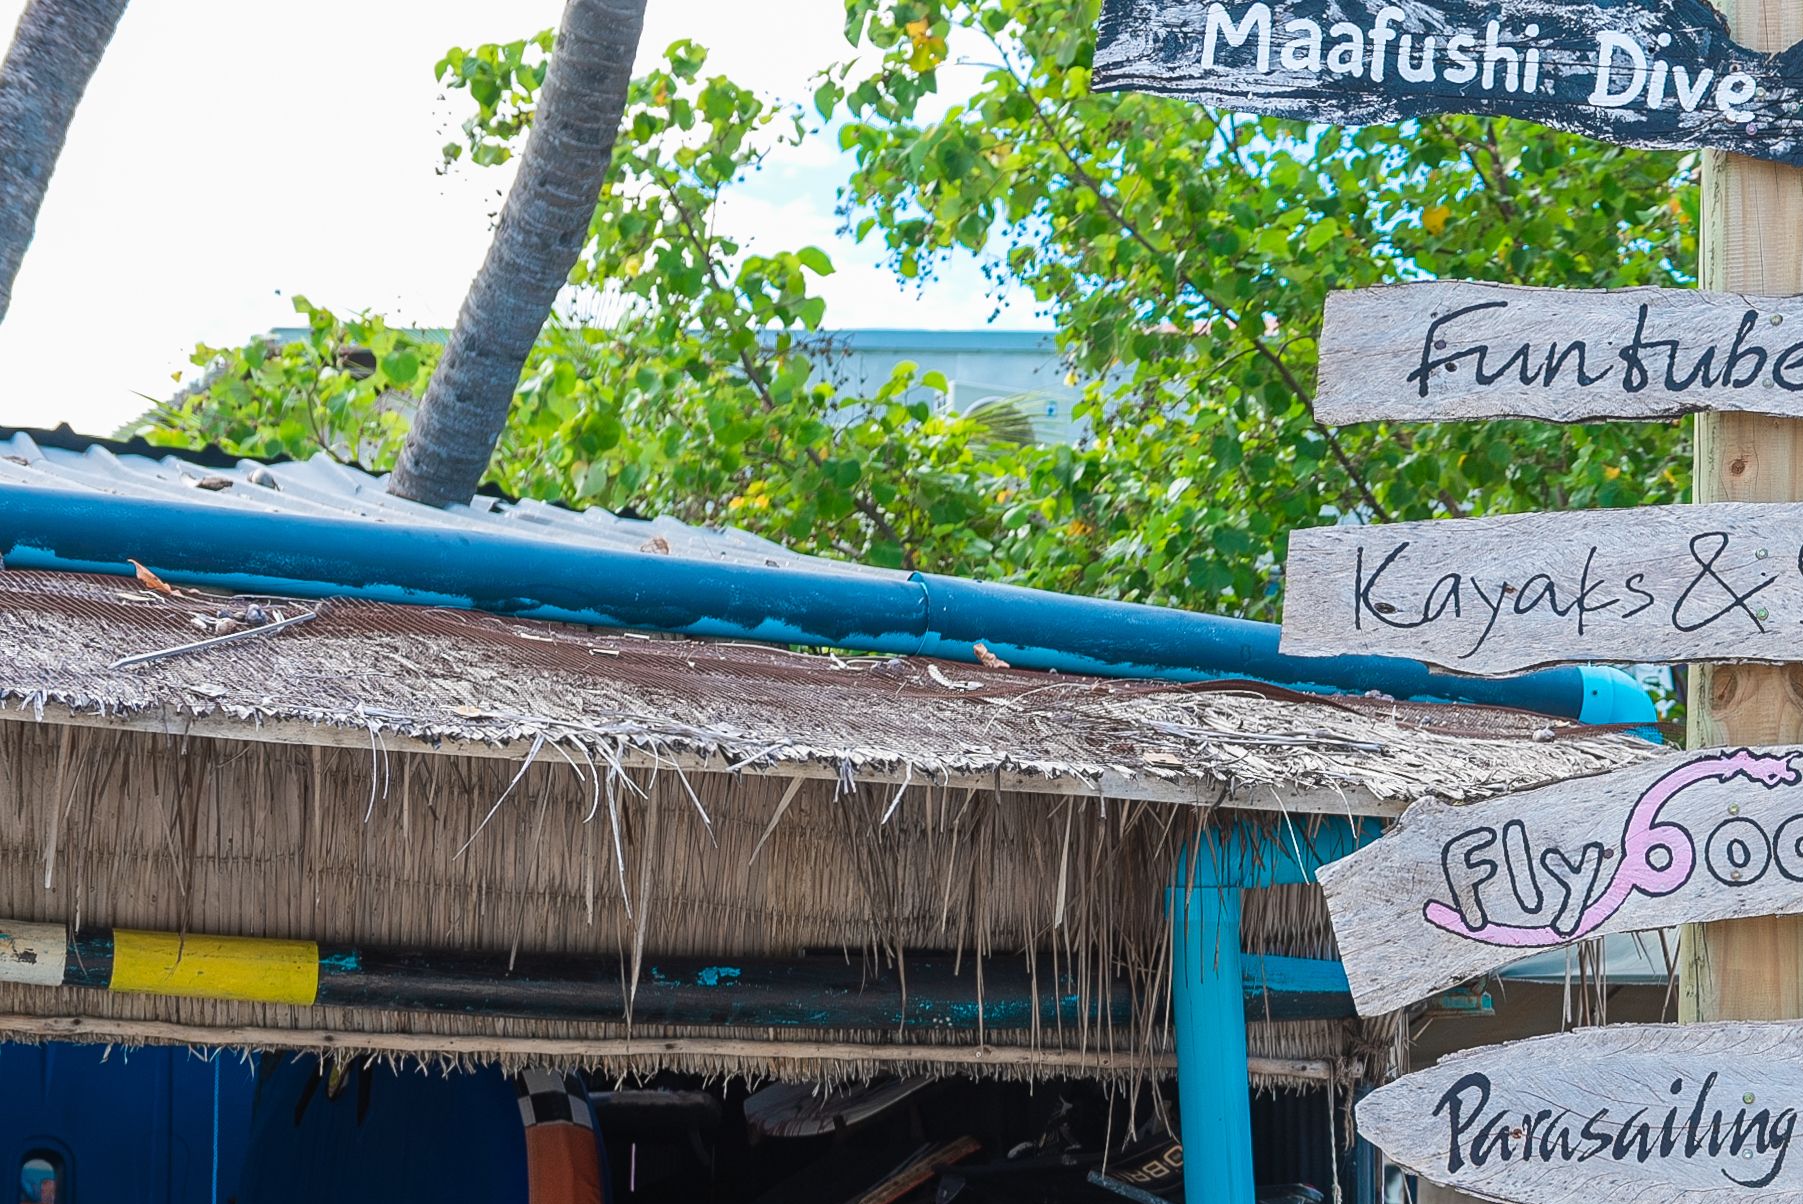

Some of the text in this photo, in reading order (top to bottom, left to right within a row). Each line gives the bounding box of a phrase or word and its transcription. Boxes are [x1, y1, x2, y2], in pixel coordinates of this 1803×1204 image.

[1201, 1, 1540, 94] Maafushi
[1588, 29, 1757, 123] Dive
[1354, 541, 1655, 659] Kayaks
[1672, 531, 1779, 633] &
[1432, 1071, 1798, 1189] Parasailing
